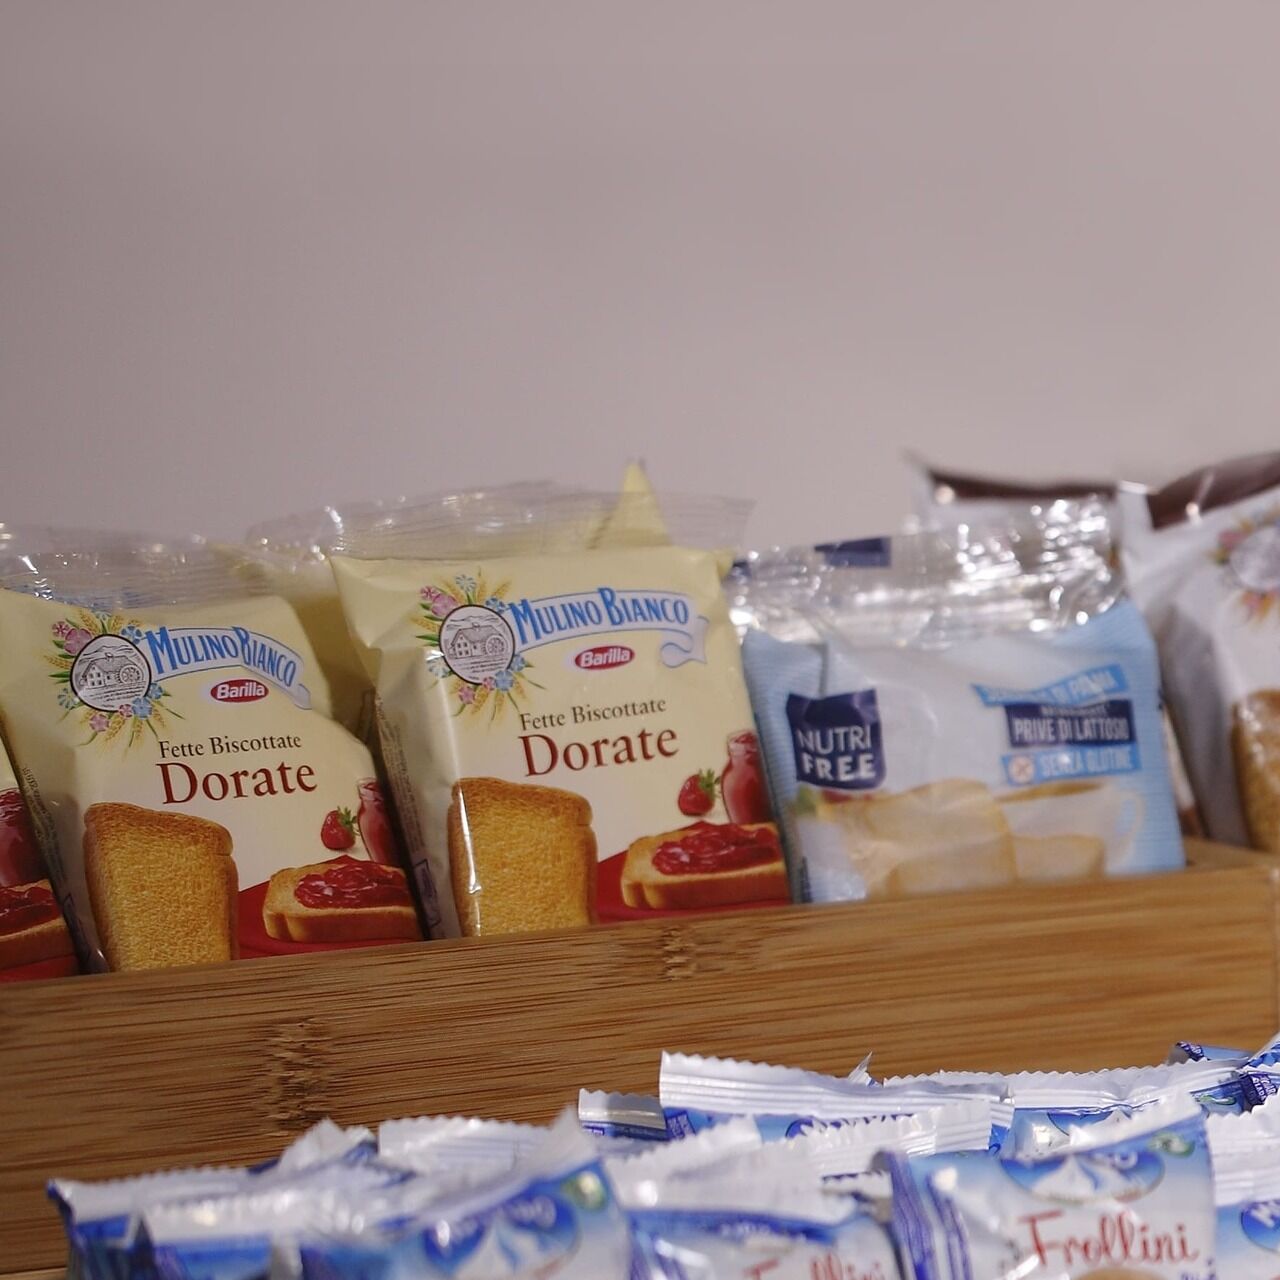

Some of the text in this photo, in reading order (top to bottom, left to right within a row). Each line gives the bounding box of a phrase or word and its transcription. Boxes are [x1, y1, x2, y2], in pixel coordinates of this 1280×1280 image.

[509, 587, 689, 645] MULINO BIANCO
[144, 626, 297, 688] MULINO BIANCO
[580, 647, 632, 668] Barilla
[216, 681, 266, 700] Barilla
[519, 698, 667, 731] Fette Biscottate
[158, 734, 302, 759] Fette Biscottate
[517, 726, 680, 777] Dorate
[796, 725, 872, 755] NUTRI
[155, 761, 318, 804] Dorate
[802, 752, 877, 781] FREE
[1018, 1208, 1200, 1266] Frollini
